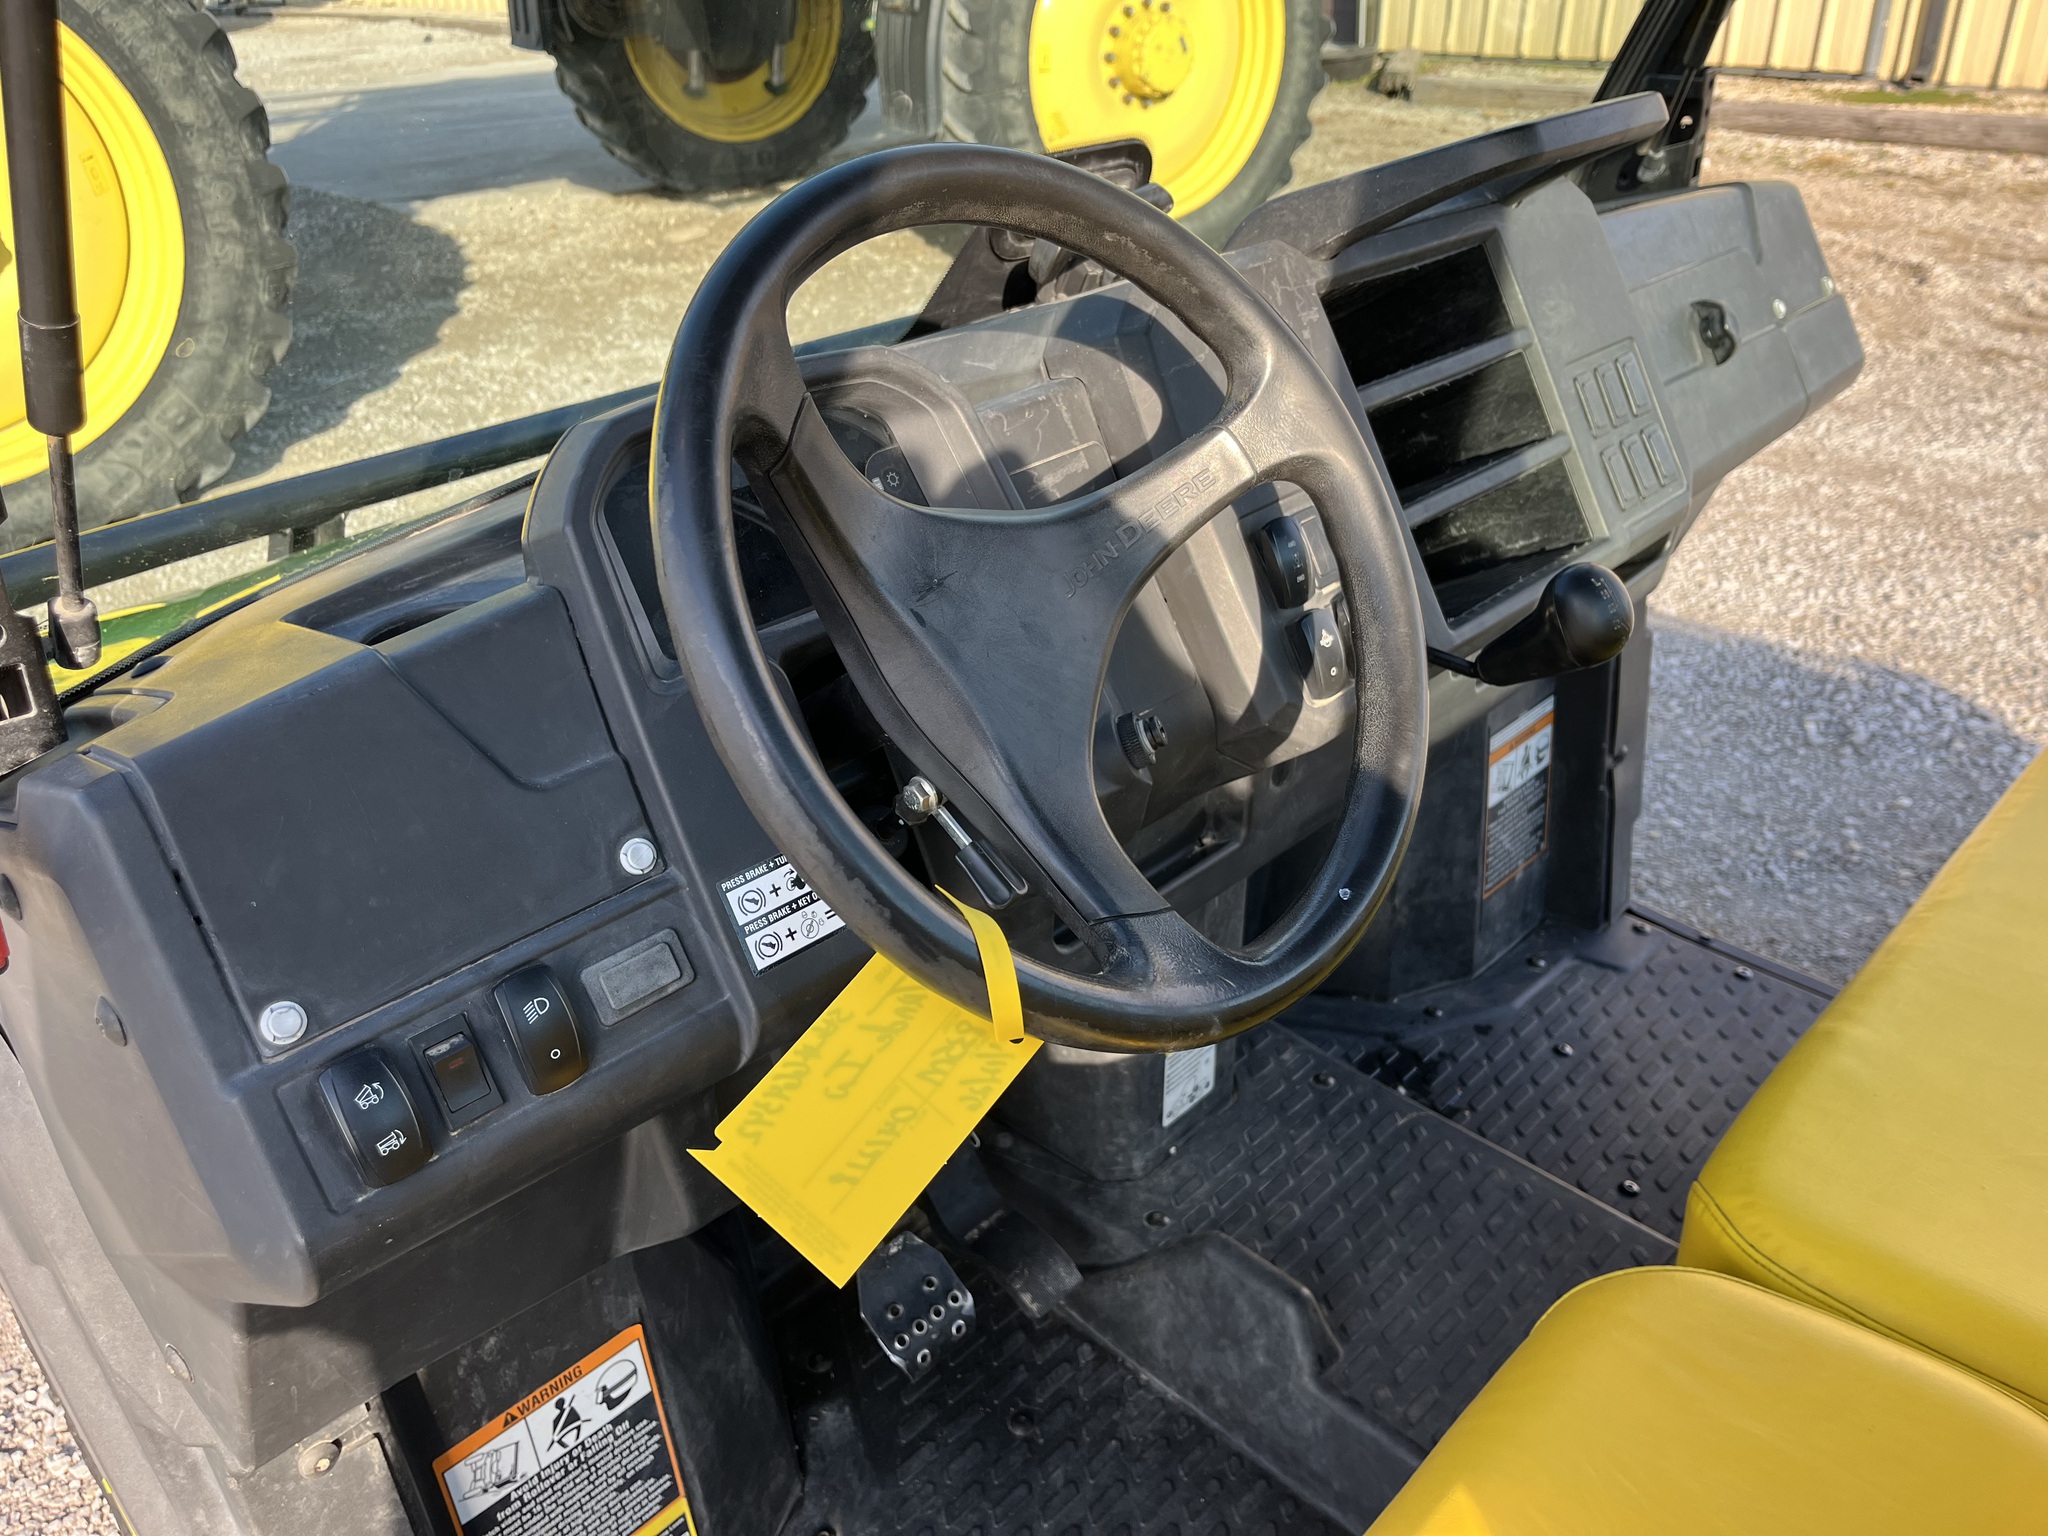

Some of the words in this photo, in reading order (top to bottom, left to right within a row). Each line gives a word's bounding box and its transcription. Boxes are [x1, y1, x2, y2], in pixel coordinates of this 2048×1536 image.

[1062, 540, 1119, 599] JOHN
[1116, 467, 1217, 549] DEERE
[721, 875, 745, 892] PRESS
[745, 864, 769, 882] BRAKE
[744, 919, 768, 935] PRESS
[768, 907, 792, 923] BRAKE
[797, 895, 812, 909] KEY
[517, 1365, 583, 1416] WARNING
[496, 1500, 521, 1521] from
[522, 1468, 565, 1502] Rollover
[567, 1458, 578, 1471] or
[580, 1433, 614, 1461] Falling
[615, 1419, 630, 1436] Off
[510, 1475, 539, 1501] Avoid
[540, 1454, 569, 1479] Injury
[571, 1445, 584, 1457] or
[584, 1424, 613, 1448] Death
